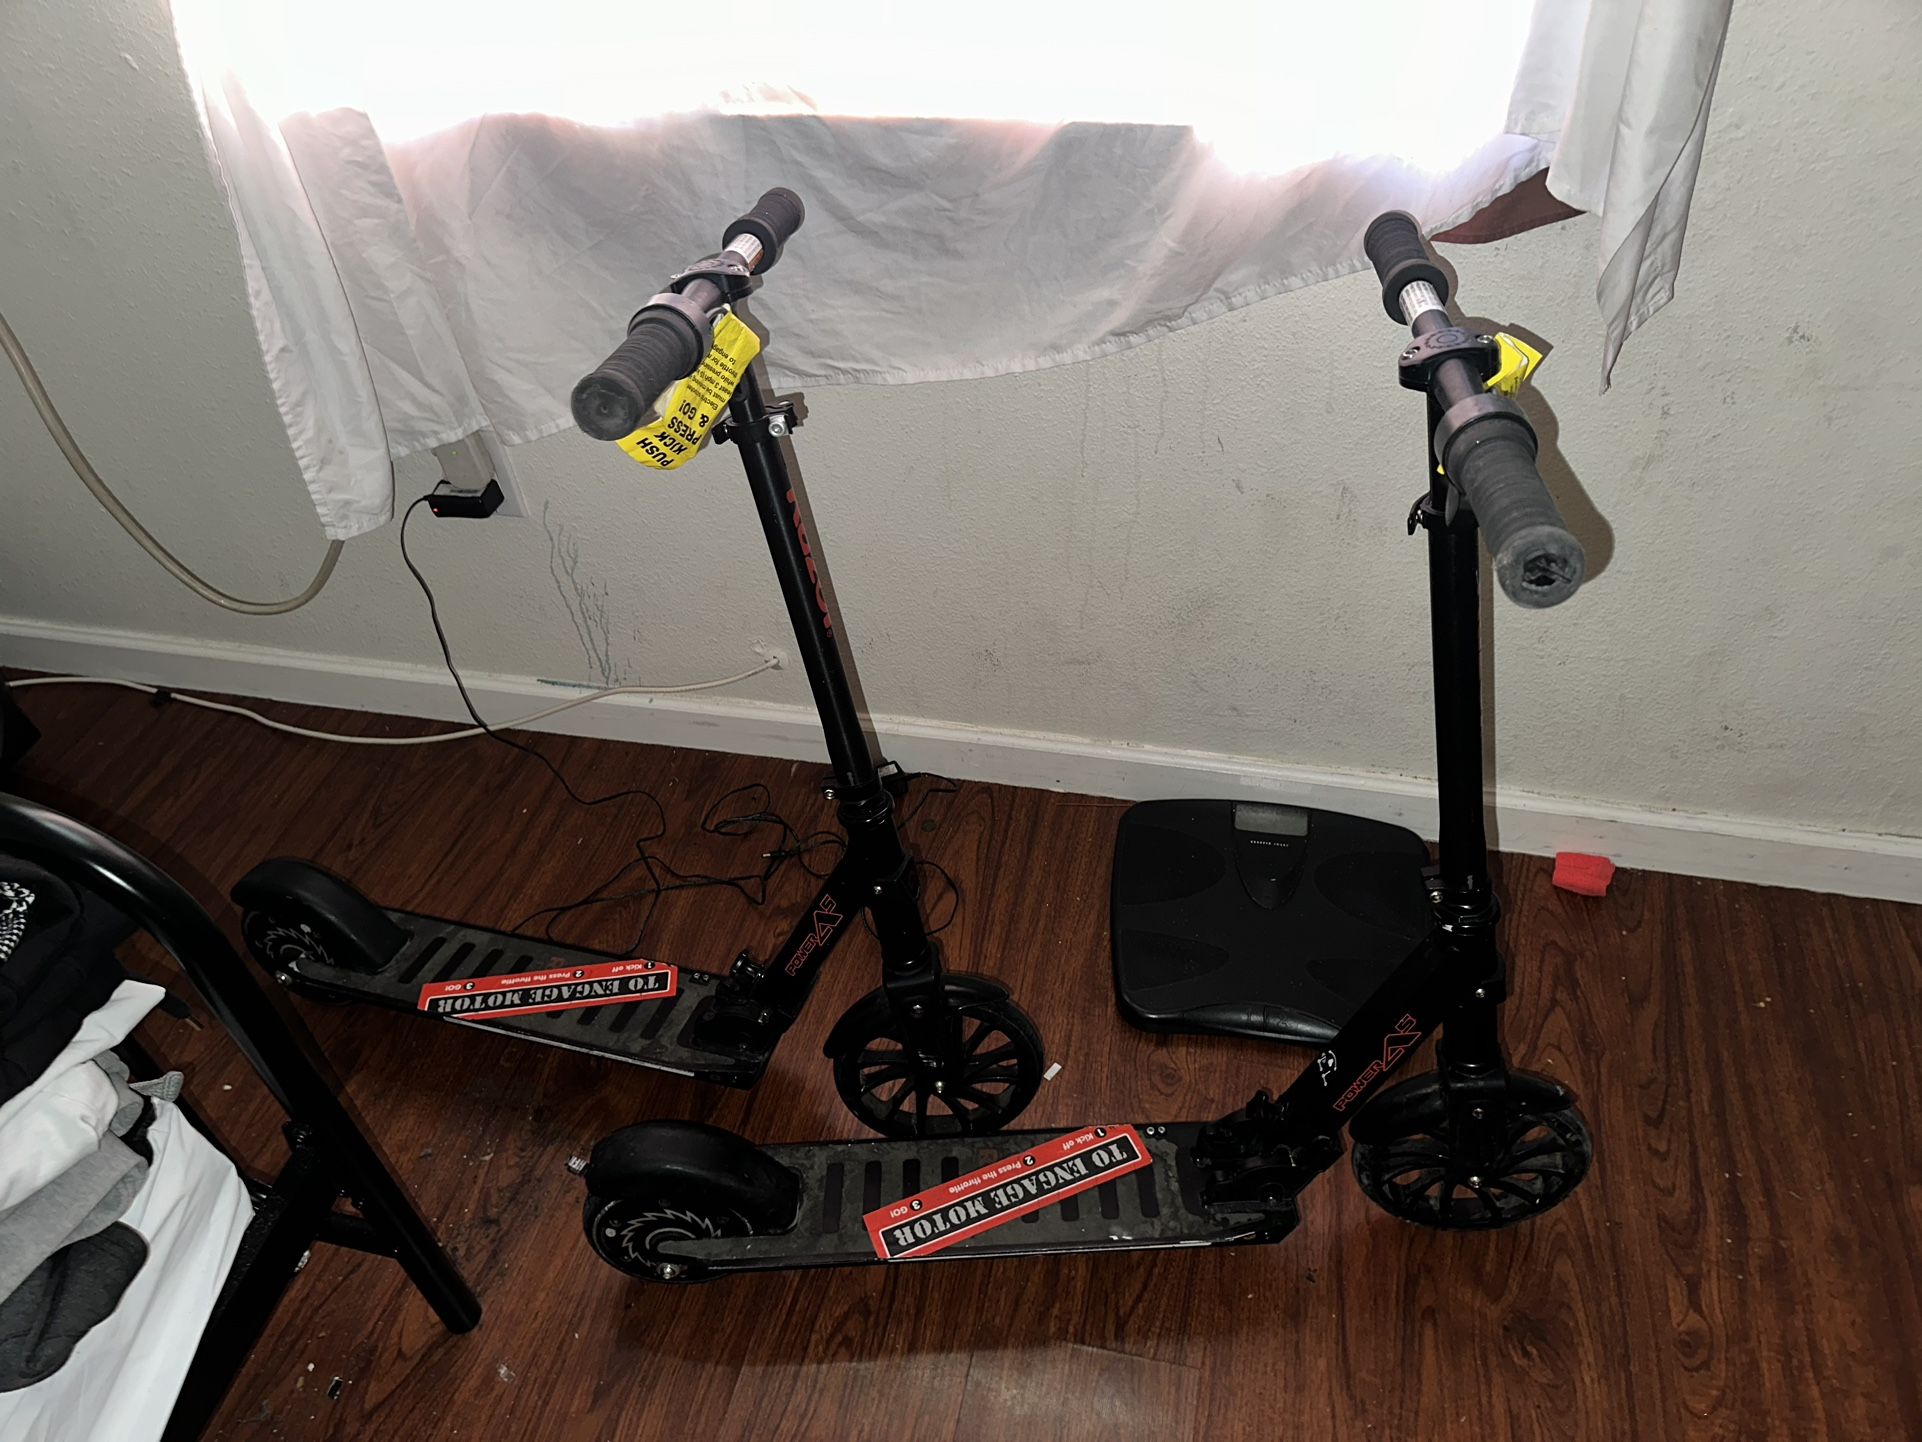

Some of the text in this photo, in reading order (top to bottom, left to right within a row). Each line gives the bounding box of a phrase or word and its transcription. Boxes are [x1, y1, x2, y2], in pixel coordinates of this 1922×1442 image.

[712, 344, 728, 359] engag
[712, 357, 720, 365] for
[704, 374, 714, 385] mph
[720, 375, 734, 386] while
[712, 392, 726, 403] must
[678, 400, 709, 428] & GO!
[667, 416, 702, 445] PRESS
[653, 431, 688, 455] KICK
[636, 438, 674, 466] PUSH
[784, 933, 818, 976] POWER
[501, 976, 531, 984] throttle
[438, 976, 659, 1012] TO ENGAGE MOTOR
[1332, 1059, 1384, 1112] POWER
[1063, 1139, 1074, 1150] off
[1076, 1133, 1094, 1144] Kick
[982, 1171, 998, 1180] the
[998, 1163, 1022, 1175] Press
[949, 1178, 981, 1193] throttle
[893, 1144, 1127, 1246] TO ENGAGE MOTOR
[890, 1206, 908, 1218] GO!
